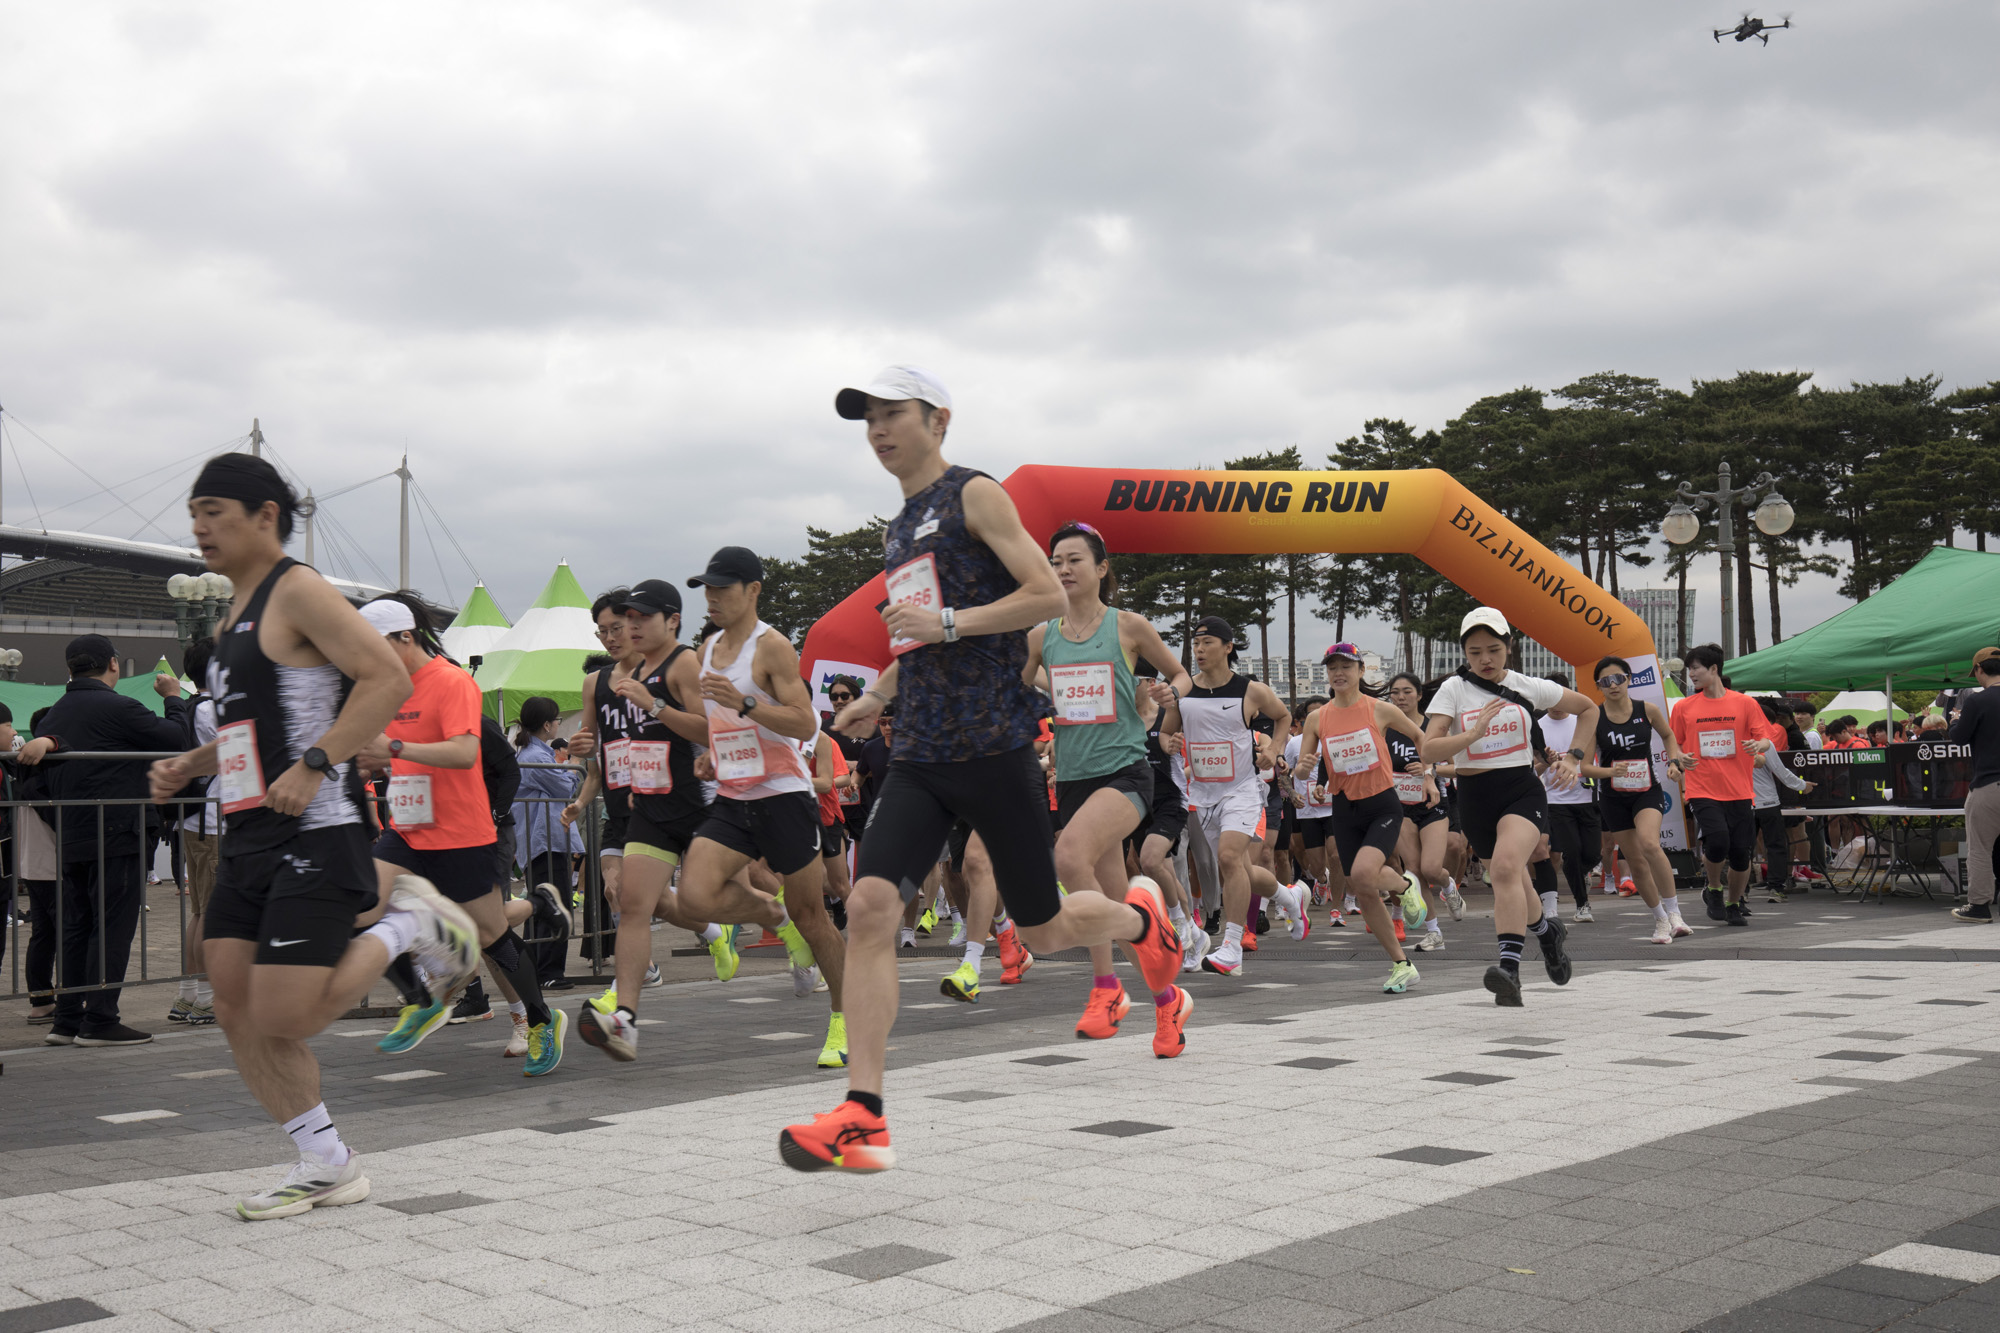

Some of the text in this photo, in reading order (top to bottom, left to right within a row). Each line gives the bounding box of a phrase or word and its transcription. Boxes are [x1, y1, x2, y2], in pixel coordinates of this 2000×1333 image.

[1104, 479, 1389, 513] BURNING RUN
[1248, 515, 1382, 528] Casual Running Festival
[1056, 684, 1105, 699] W 3544
[1710, 739, 1732, 747] 2136
[728, 747, 758, 761] 1288
[1341, 742, 1372, 758] 3532
[1201, 756, 1228, 766] 1630
[1857, 752, 1881, 762] 10km
[638, 760, 662, 772] 1041
[1399, 783, 1422, 792] 3026
[1875, 780, 1886, 799] 4
[394, 794, 424, 807] 1314
